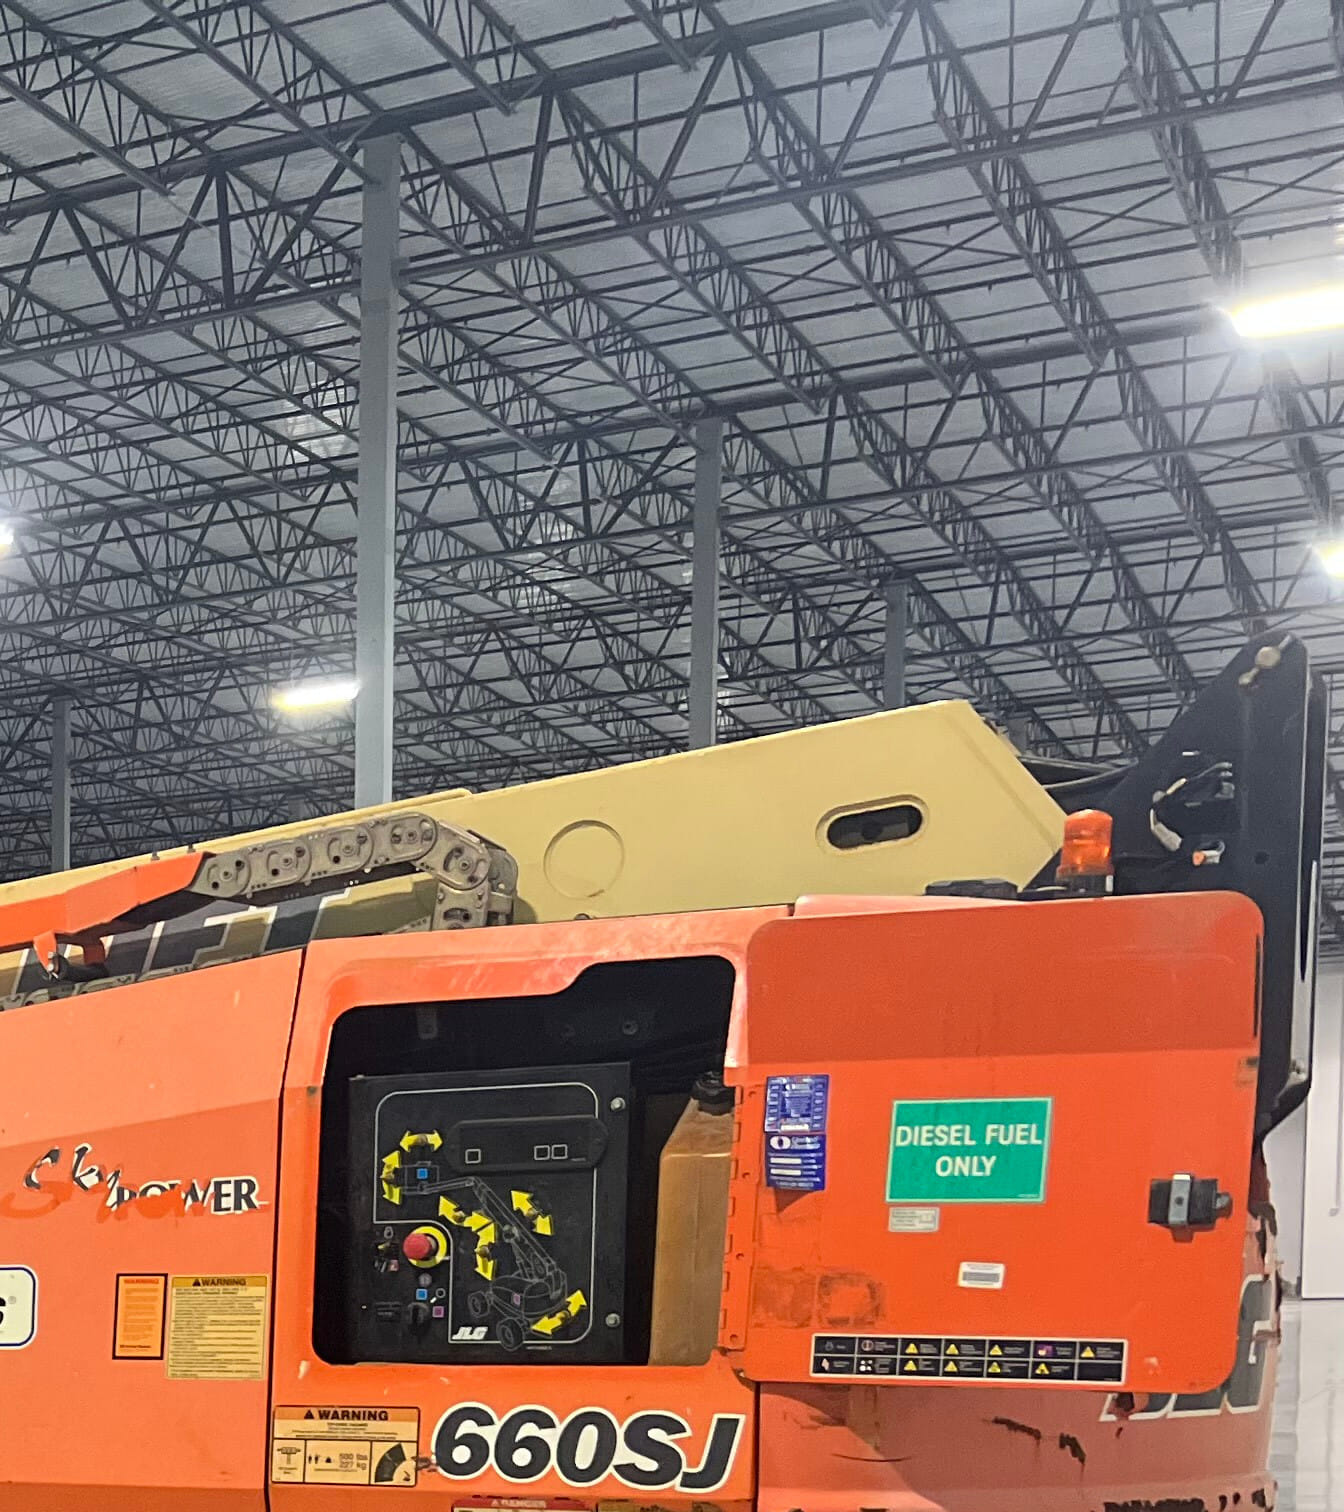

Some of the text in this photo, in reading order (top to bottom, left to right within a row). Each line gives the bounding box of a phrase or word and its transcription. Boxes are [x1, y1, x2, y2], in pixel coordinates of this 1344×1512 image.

[895, 1123, 1043, 1147] DIESEL FUEL
[935, 1155, 997, 1177] ONLY
[452, 1326, 489, 1340] JLG
[318, 1410, 389, 1421] WARNING
[433, 1402, 745, 1493] 660SJ
